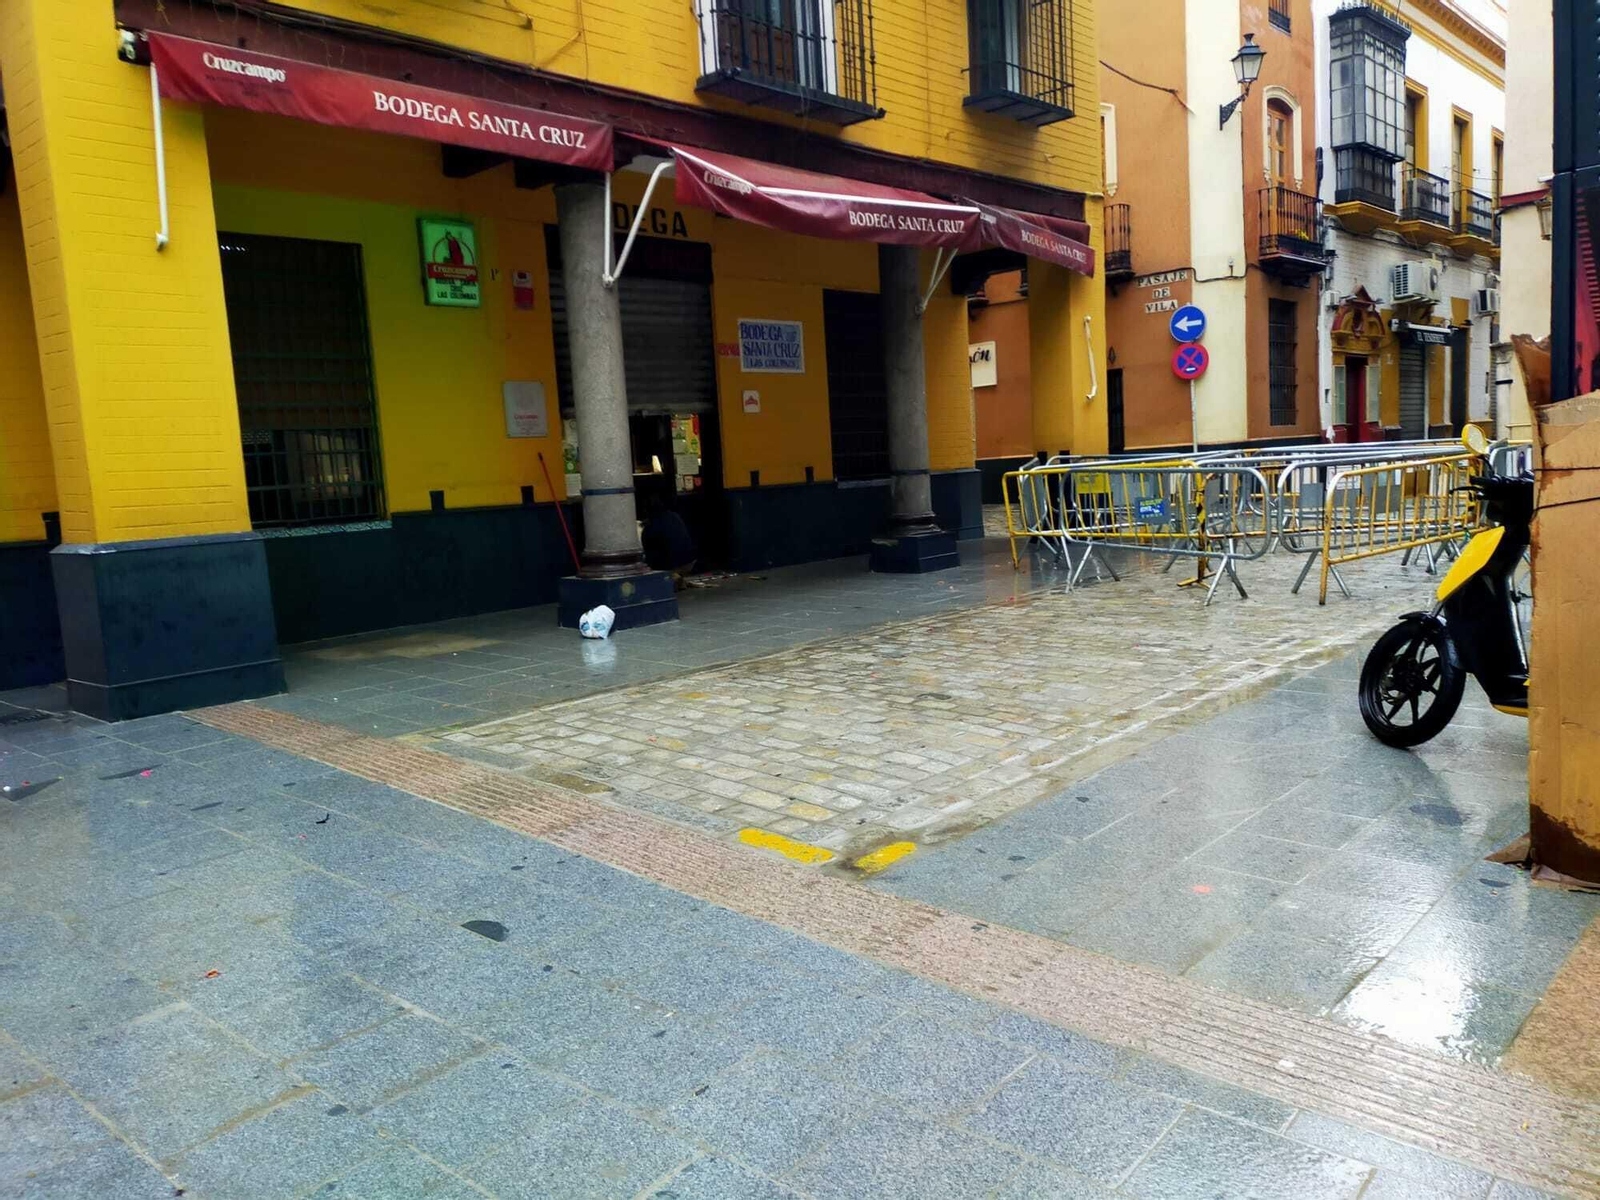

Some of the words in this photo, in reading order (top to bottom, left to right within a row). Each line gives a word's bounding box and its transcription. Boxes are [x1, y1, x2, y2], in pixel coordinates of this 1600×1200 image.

[202, 52, 286, 83] Cruzcampo
[372, 90, 465, 128] BODEGA
[468, 111, 536, 140] SANTA
[538, 125, 587, 150] CRUZ
[848, 209, 895, 230] BODEGA
[897, 213, 936, 233] SANTA
[937, 218, 965, 235] CRUZ
[1020, 229, 1050, 248] BODEGA
[1050, 239, 1073, 258] SANTA
[1137, 270, 1186, 287] PASAJE
[1153, 287, 1170, 299] DE
[1145, 300, 1177, 312] VILA
[740, 323, 783, 340] BODEGA
[743, 341, 772, 357] SANTA
[773, 343, 801, 358] CRUZ
